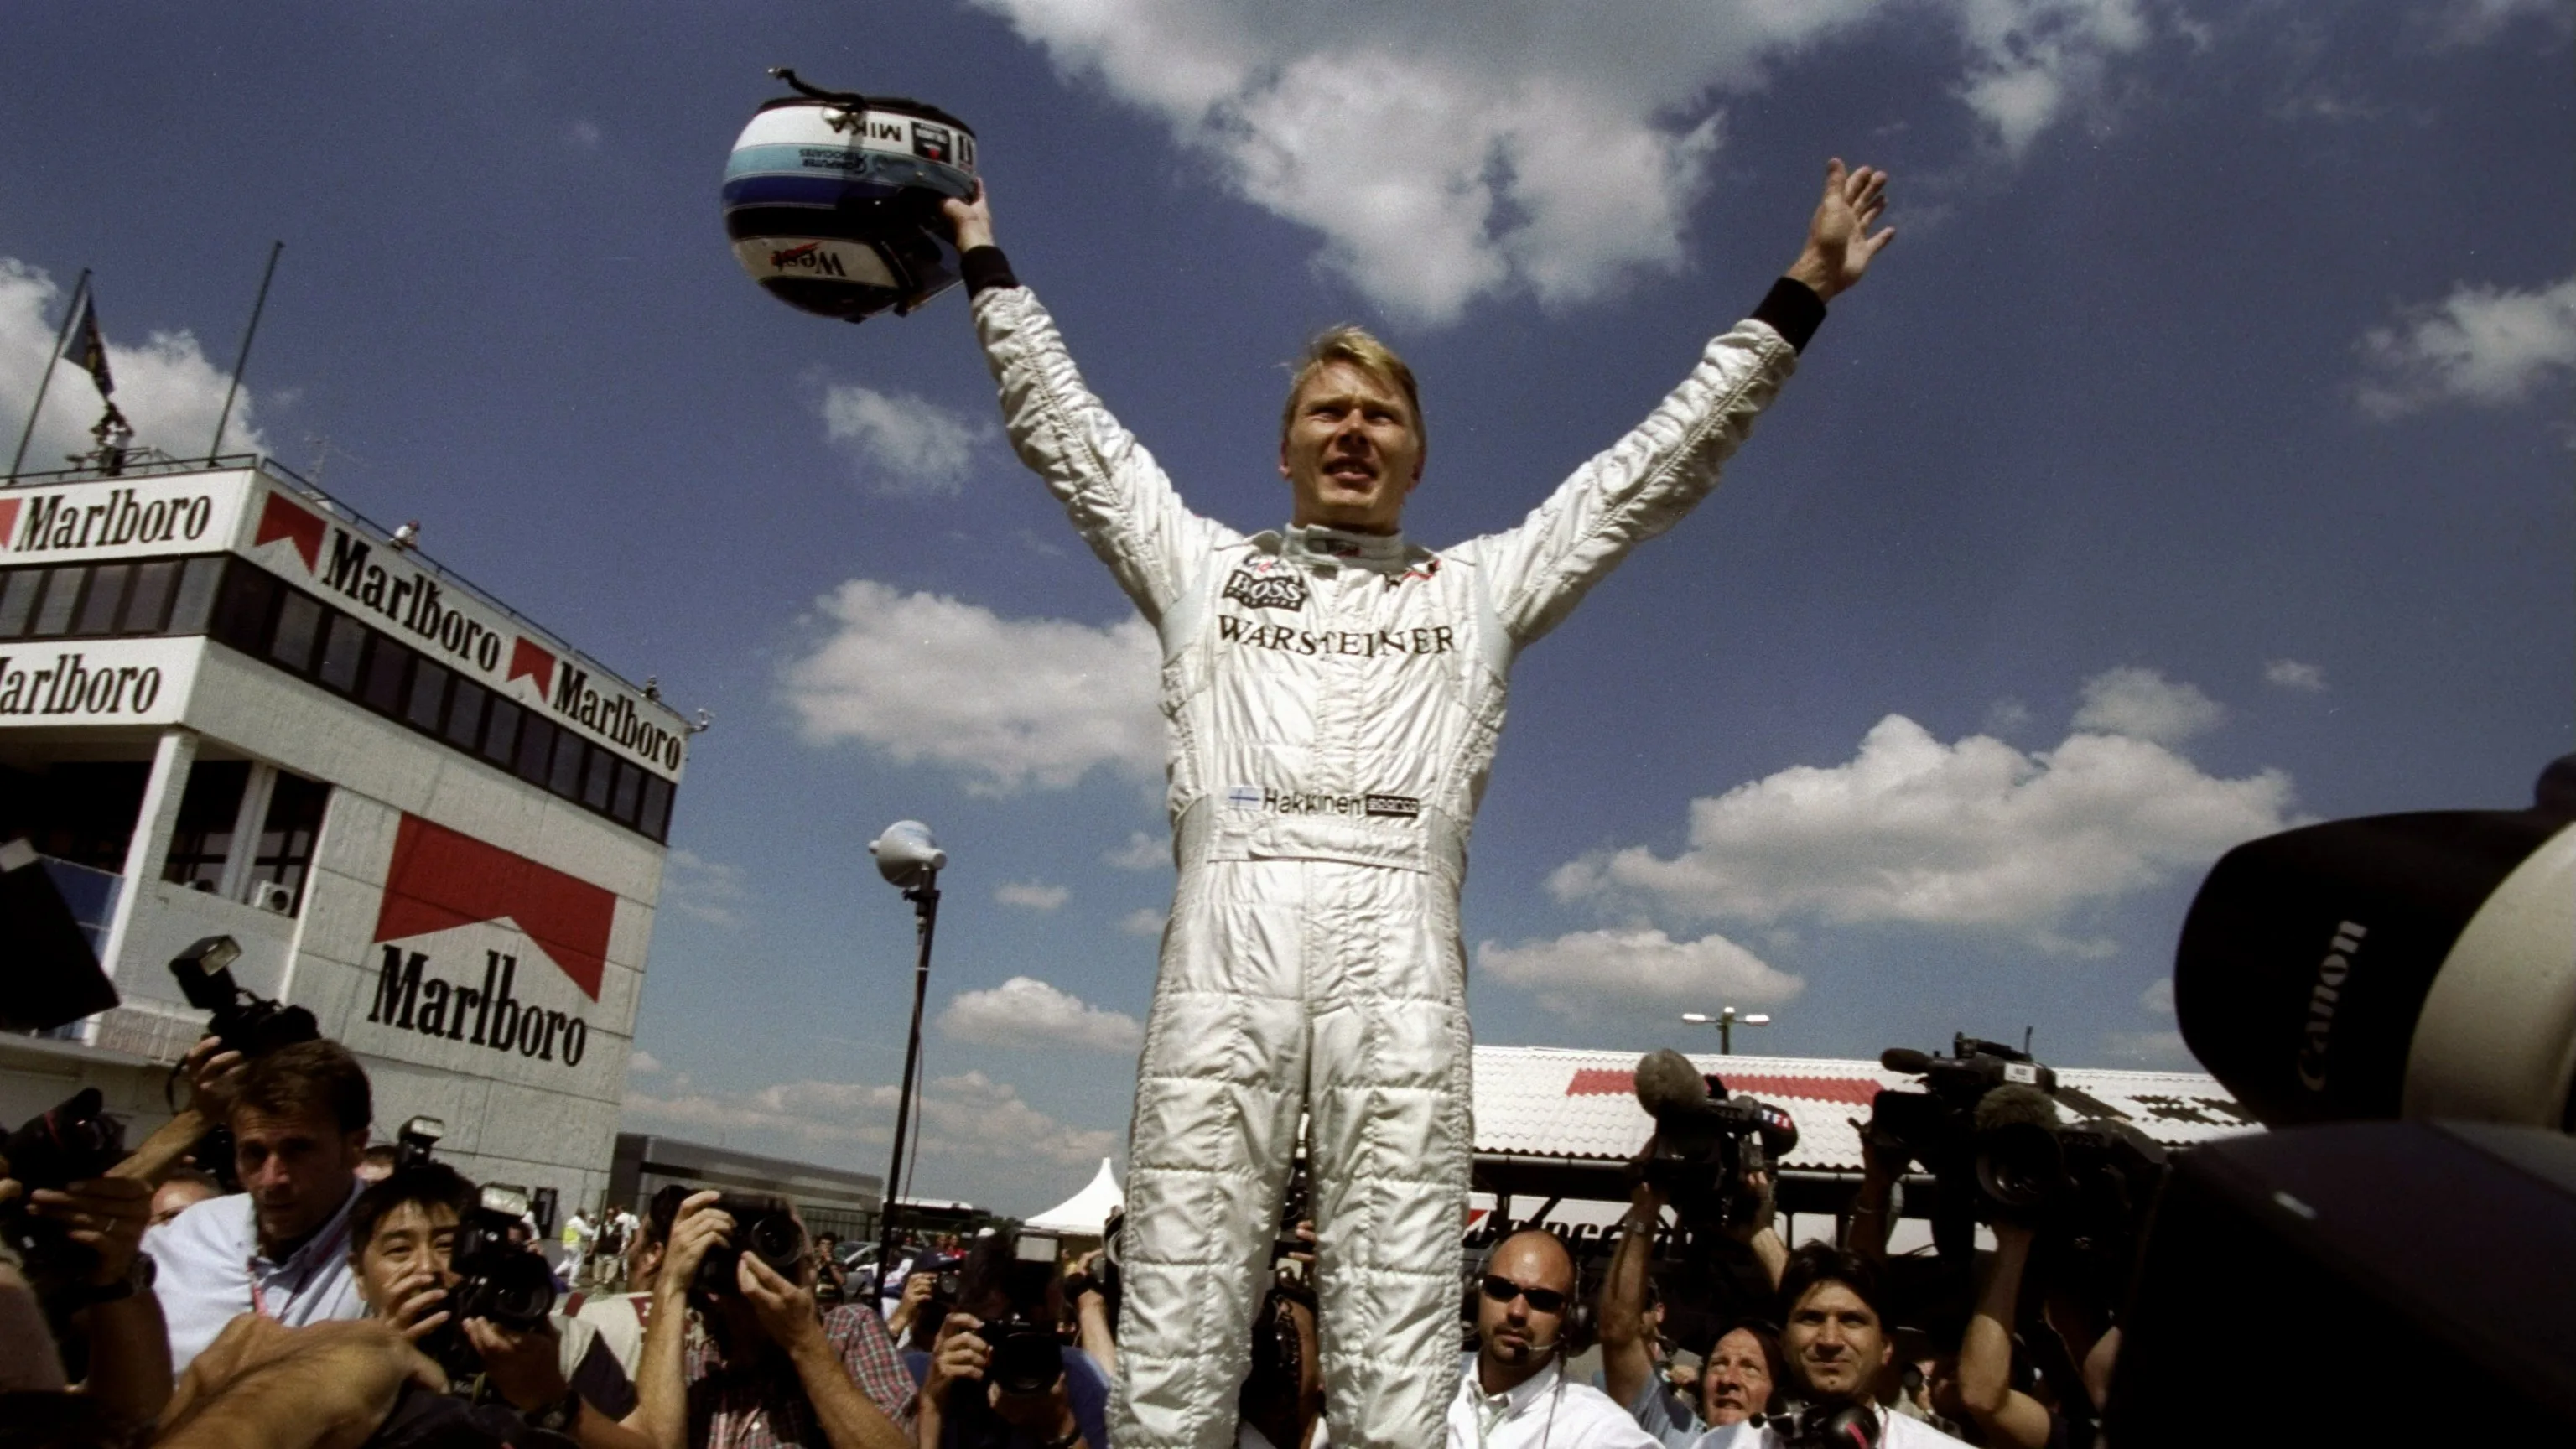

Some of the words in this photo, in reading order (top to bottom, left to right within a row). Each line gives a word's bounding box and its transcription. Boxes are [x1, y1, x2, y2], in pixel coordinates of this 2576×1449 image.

[828, 114, 901, 142] MIKA
[771, 251, 847, 278] West
[14, 488, 210, 552] Marlboro
[322, 528, 501, 672] Marlboro
[1231, 573, 1301, 601] BOSS
[1217, 615, 1454, 658] WARSTEINER
[0, 654, 161, 714] arlboro
[553, 661, 683, 772] Marlboro
[367, 943, 585, 1067] Marlboro
[2296, 919, 2370, 1093] Canon
[1762, 1109, 1790, 1129] TF1
